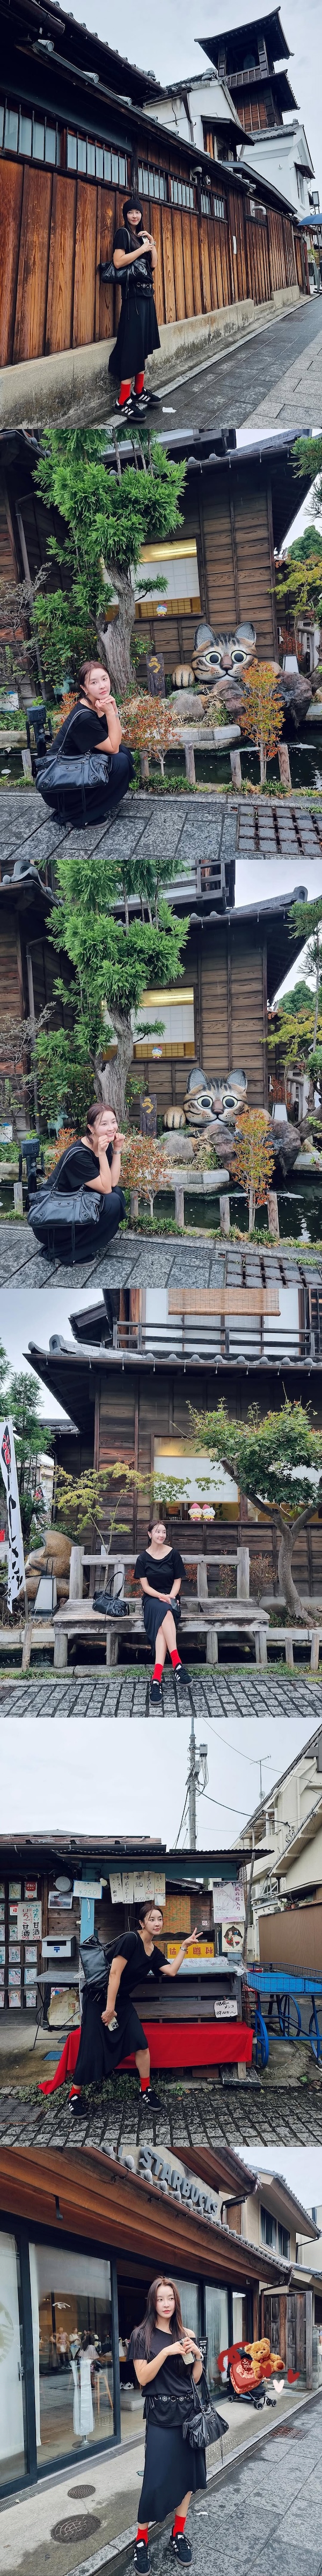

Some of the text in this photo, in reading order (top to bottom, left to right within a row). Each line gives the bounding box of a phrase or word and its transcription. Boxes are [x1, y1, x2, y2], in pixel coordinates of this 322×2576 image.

[135, 1875, 143, 1888] 甘酒
[21, 1909, 31, 1936] いちご甘酒
[138, 2146, 218, 2217] STARBUCKS
